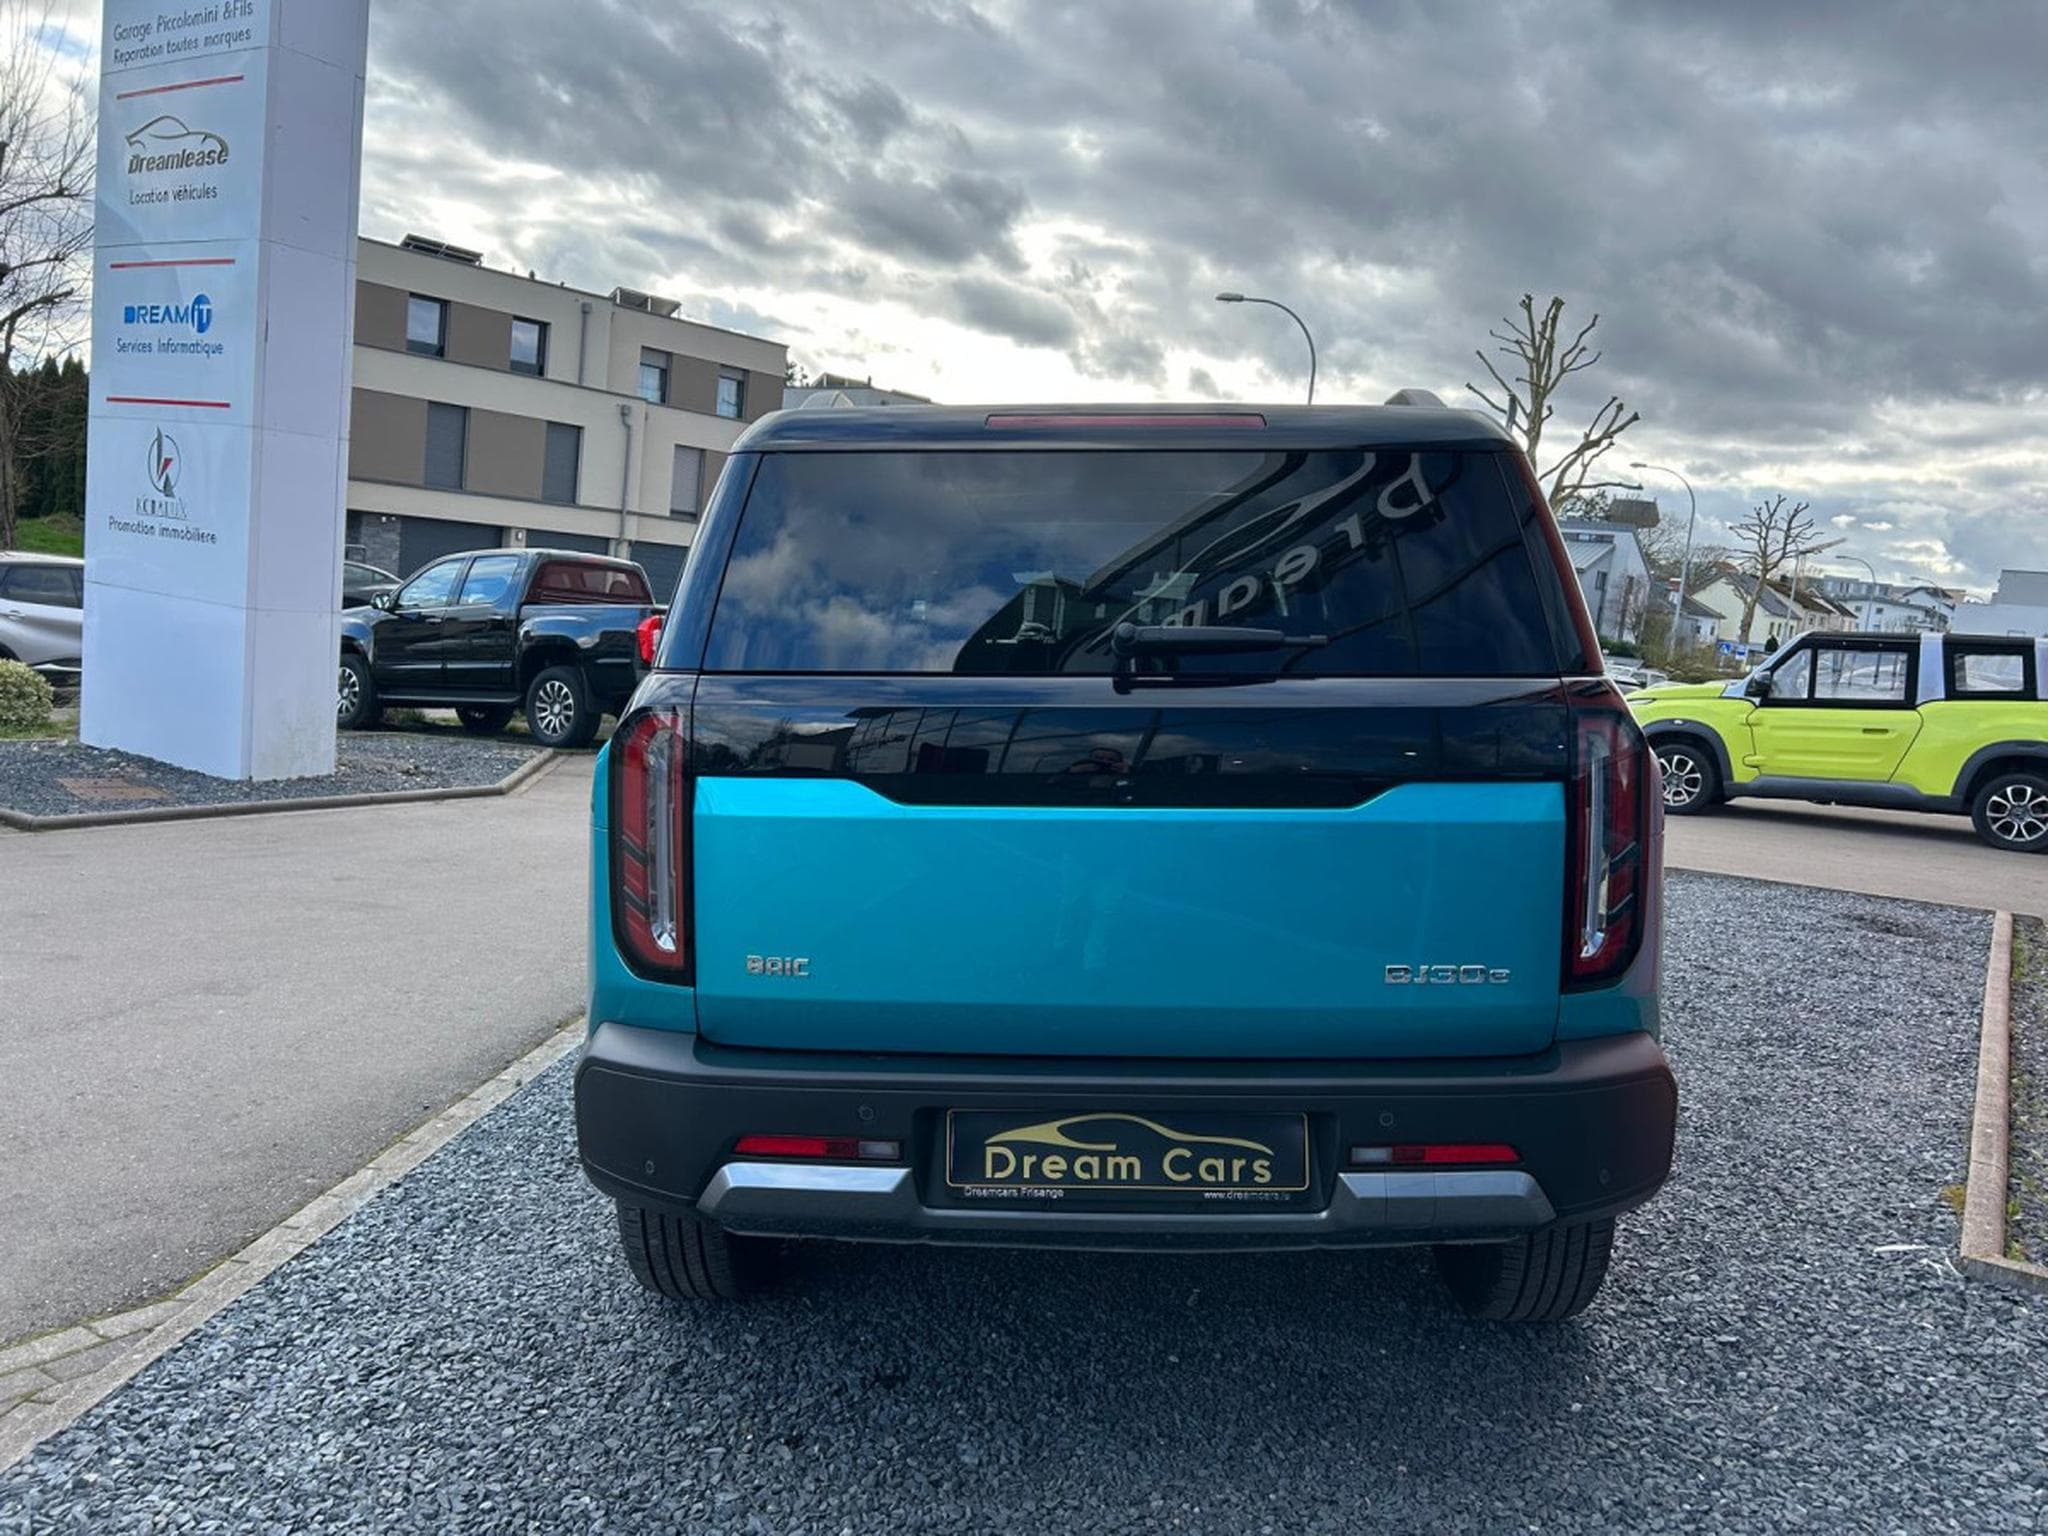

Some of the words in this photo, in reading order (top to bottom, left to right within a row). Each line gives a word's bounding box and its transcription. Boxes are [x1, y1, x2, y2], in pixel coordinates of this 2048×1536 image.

[113, 23, 152, 42] Garage
[156, 5, 218, 33] Piccolomini
[166, 36, 199, 54] toutes
[203, 27, 252, 48] marques
[128, 148, 229, 174] Dreamlease
[129, 186, 170, 205] Location
[172, 182, 218, 202] véhicules
[116, 337, 153, 353] Services
[157, 337, 224, 358] Informatique
[108, 515, 155, 536] Promotion
[746, 954, 809, 976] BAIC
[1384, 964, 1510, 984] BJ30e
[984, 1145, 1142, 1181] Dream
[1162, 1147, 1273, 1184] Cars
